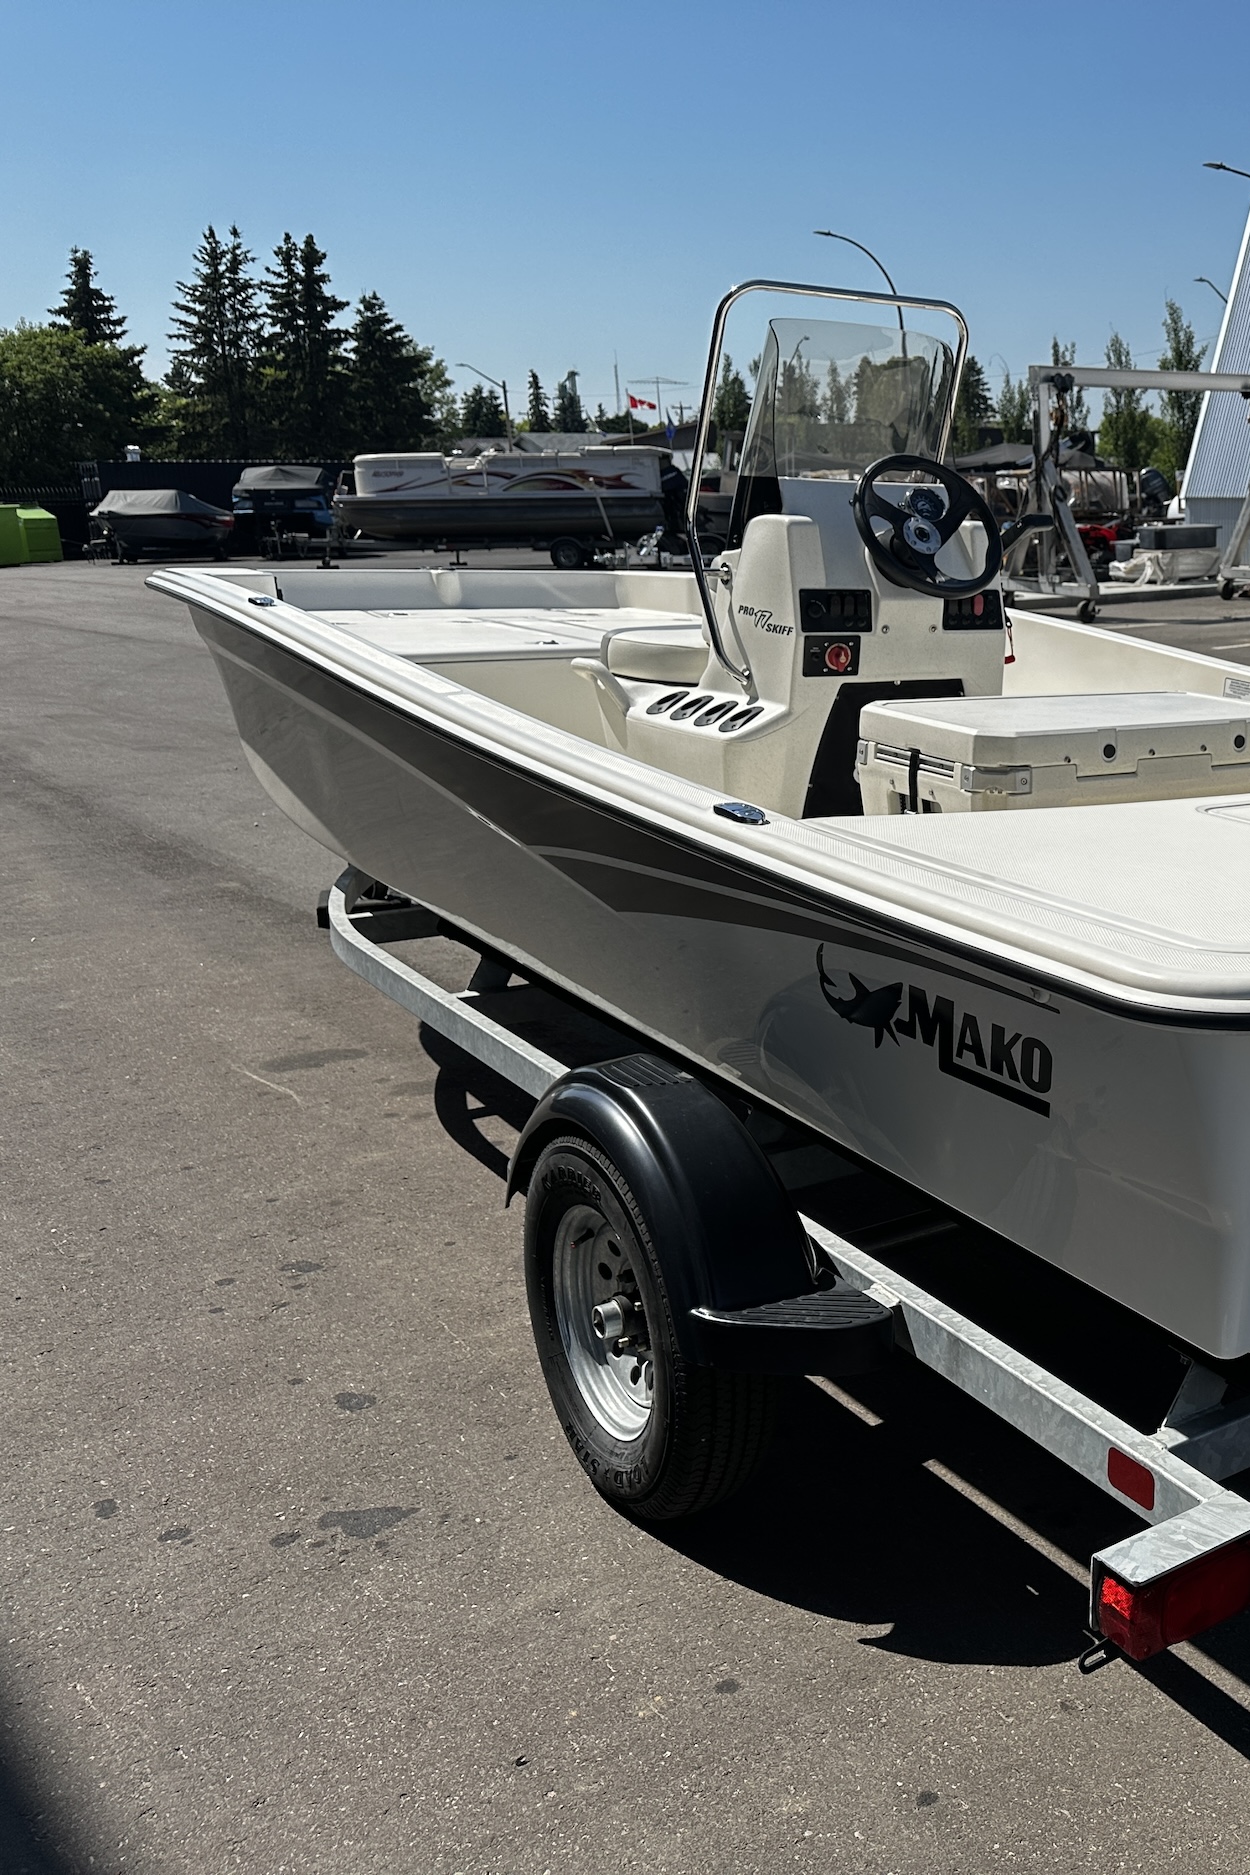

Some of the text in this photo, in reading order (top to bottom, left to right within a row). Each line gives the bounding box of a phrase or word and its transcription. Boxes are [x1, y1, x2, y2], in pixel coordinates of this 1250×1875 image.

[738, 605, 794, 636] PRO 17 SKIFF
[893, 984, 1053, 1118] MAKO
